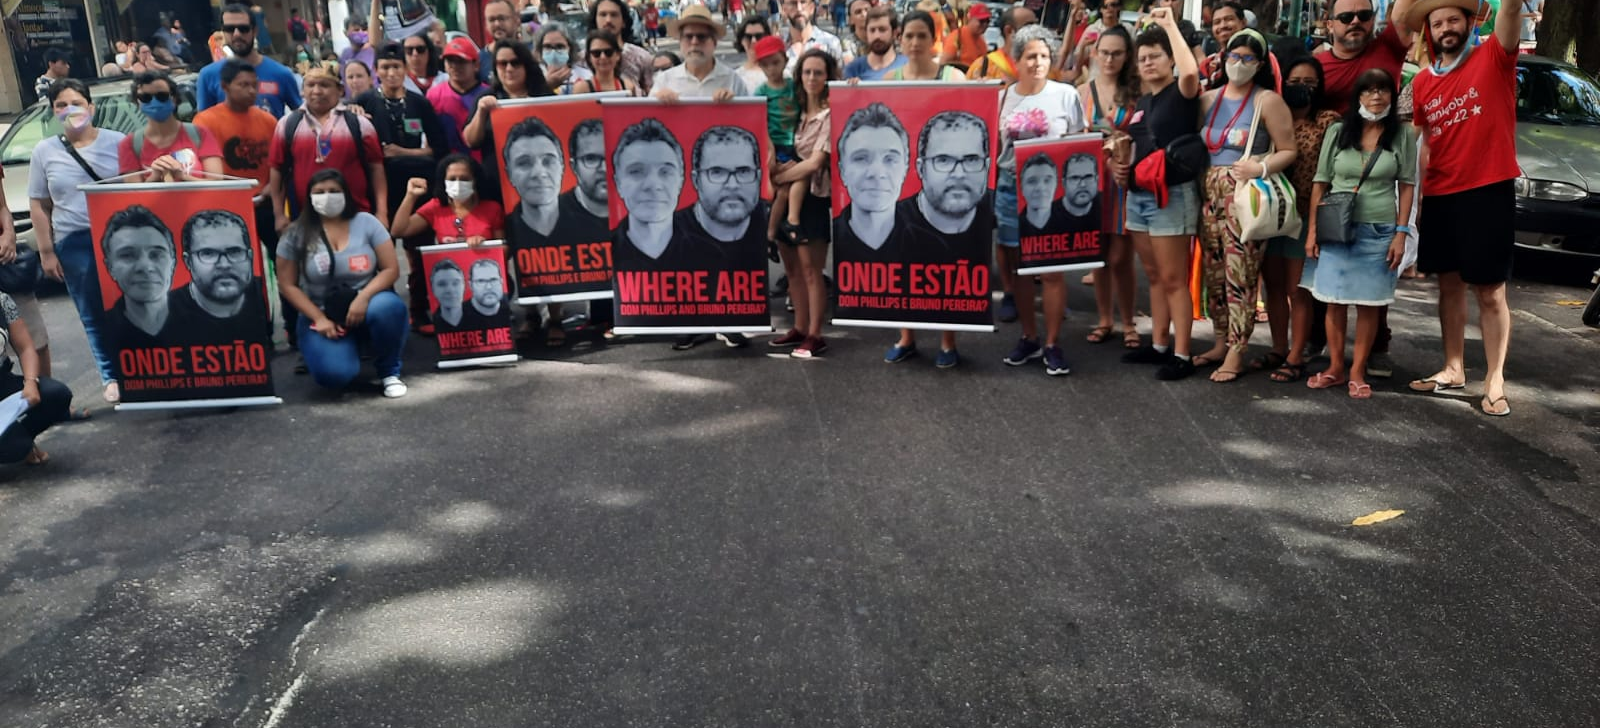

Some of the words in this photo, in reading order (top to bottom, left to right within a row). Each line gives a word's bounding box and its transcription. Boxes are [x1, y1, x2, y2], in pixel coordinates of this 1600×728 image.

[1021, 233, 1069, 254] WHERE
[1073, 230, 1101, 249] ARE
[517, 245, 574, 274] ONDE
[576, 242, 613, 270] EST
[616, 270, 710, 303] WHERE
[716, 270, 766, 302] ARE
[838, 261, 903, 293] ONDE
[909, 259, 989, 296] ESTÃO
[620, 304, 640, 316] DOM
[641, 304, 677, 316] PHILLIPS
[678, 304, 696, 315] AND
[697, 303, 725, 315] BRUNO
[727, 303, 766, 315] PEREIRA?
[838, 295, 859, 307] DOM
[860, 296, 900, 308] PHILLIPS
[902, 297, 908, 309] E
[909, 298, 941, 310] BRUNO
[943, 299, 989, 312] PEREIRA?
[437, 330, 485, 349] WHERE
[487, 327, 512, 345] ARE
[119, 347, 186, 377] ONDE
[190, 339, 266, 374] ESTÃO
[124, 378, 145, 391] DOM
[146, 377, 186, 390] PHILLIPS
[186, 377, 193, 389] E
